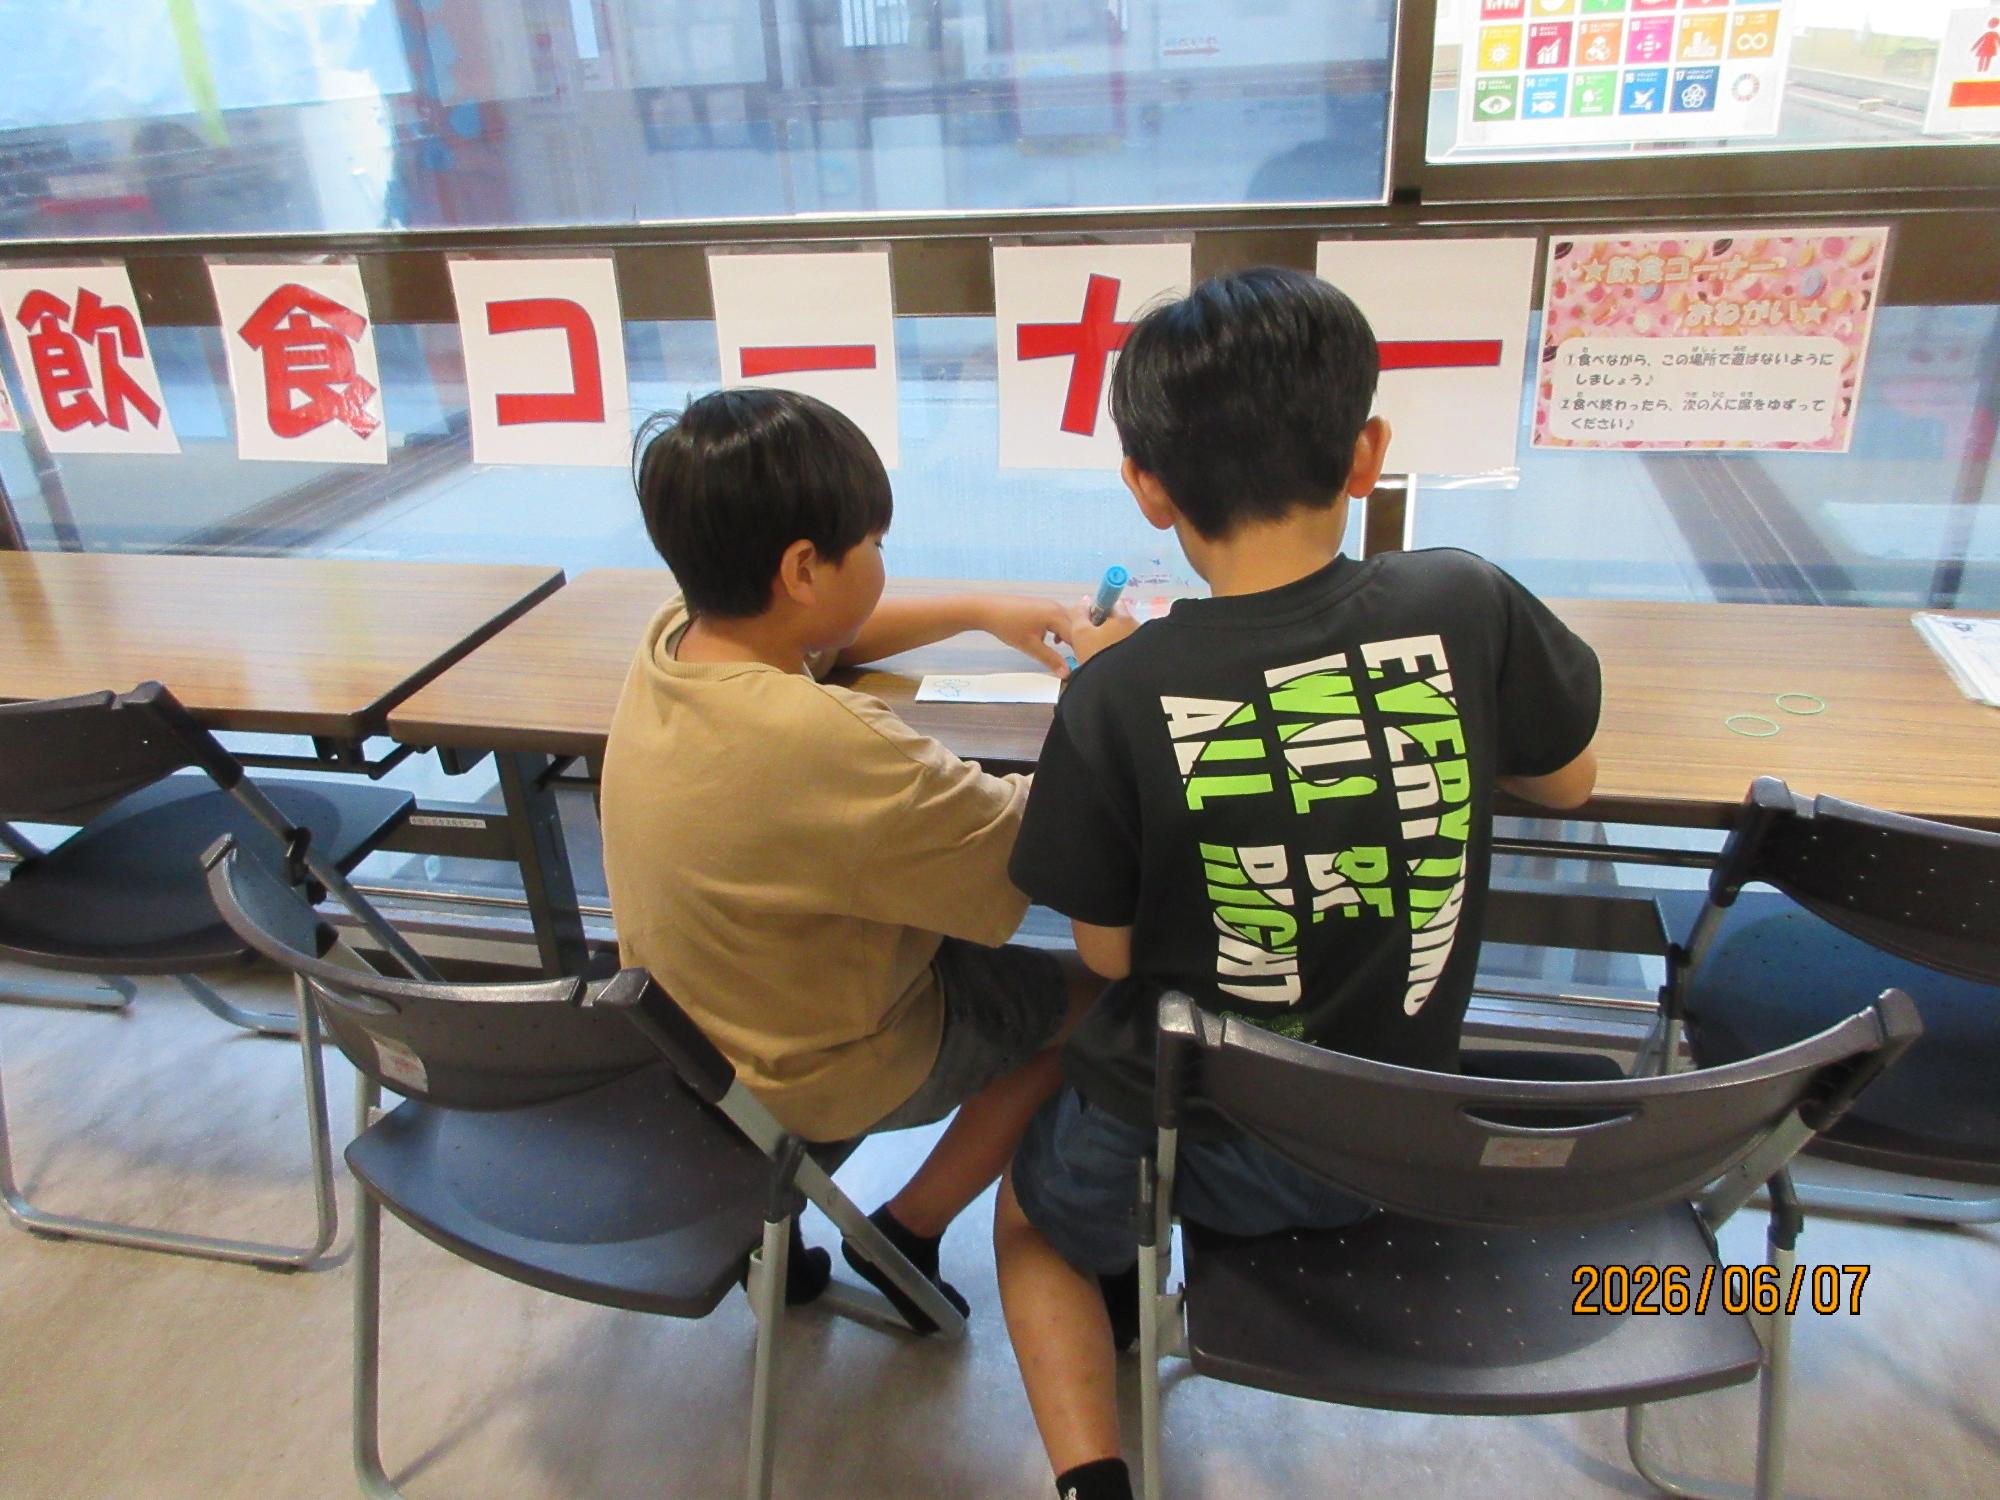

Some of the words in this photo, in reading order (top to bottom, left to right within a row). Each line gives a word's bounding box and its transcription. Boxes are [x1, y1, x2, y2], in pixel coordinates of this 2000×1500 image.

[1631, 20, 1640, 31] 10
[1477, 80, 1487, 91] 13
[1675, 70, 1685, 81] 17
[1160, 695, 1274, 811] ALL
[1264, 653, 1378, 814] WILL
[1199, 842, 1302, 1006] RIGHT
[1304, 846, 1395, 924] BE
